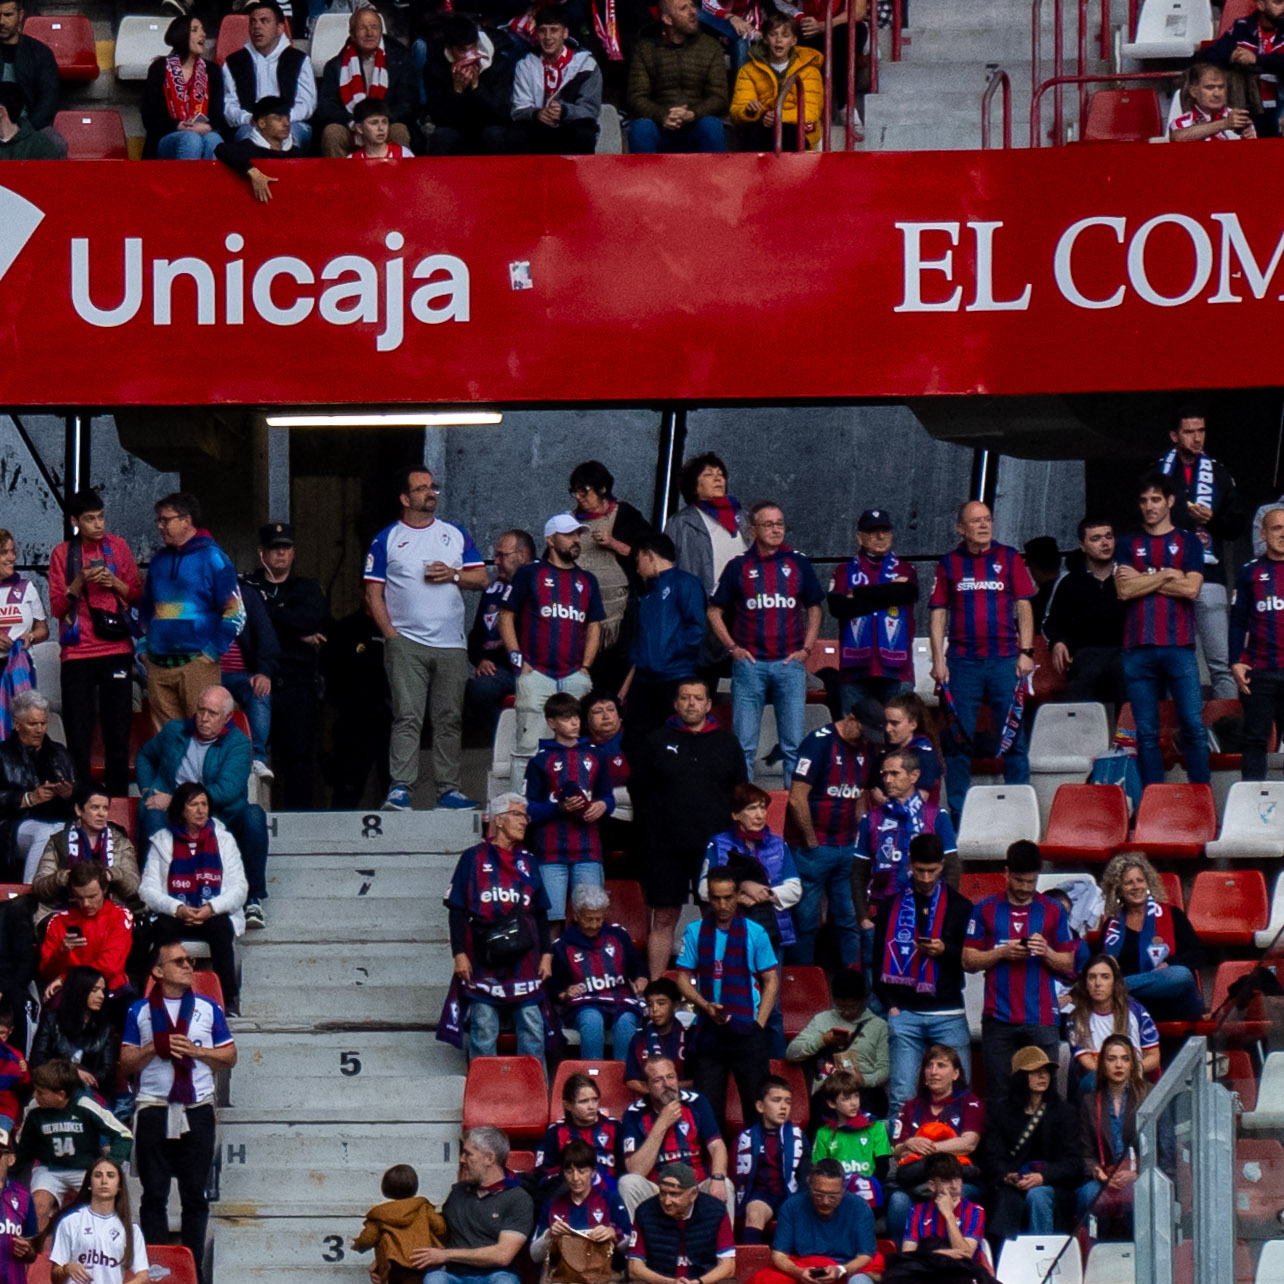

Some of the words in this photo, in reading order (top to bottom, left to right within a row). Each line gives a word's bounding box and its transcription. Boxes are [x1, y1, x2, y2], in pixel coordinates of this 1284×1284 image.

[893, 220, 1032, 312] EL
[69, 231, 472, 352] Unicaja
[956, 580, 1005, 592] SERVANDO
[746, 592, 797, 609] eibho
[361, 814, 383, 839] 8
[339, 1050, 362, 1077] 5
[321, 1235, 345, 1263] 3
